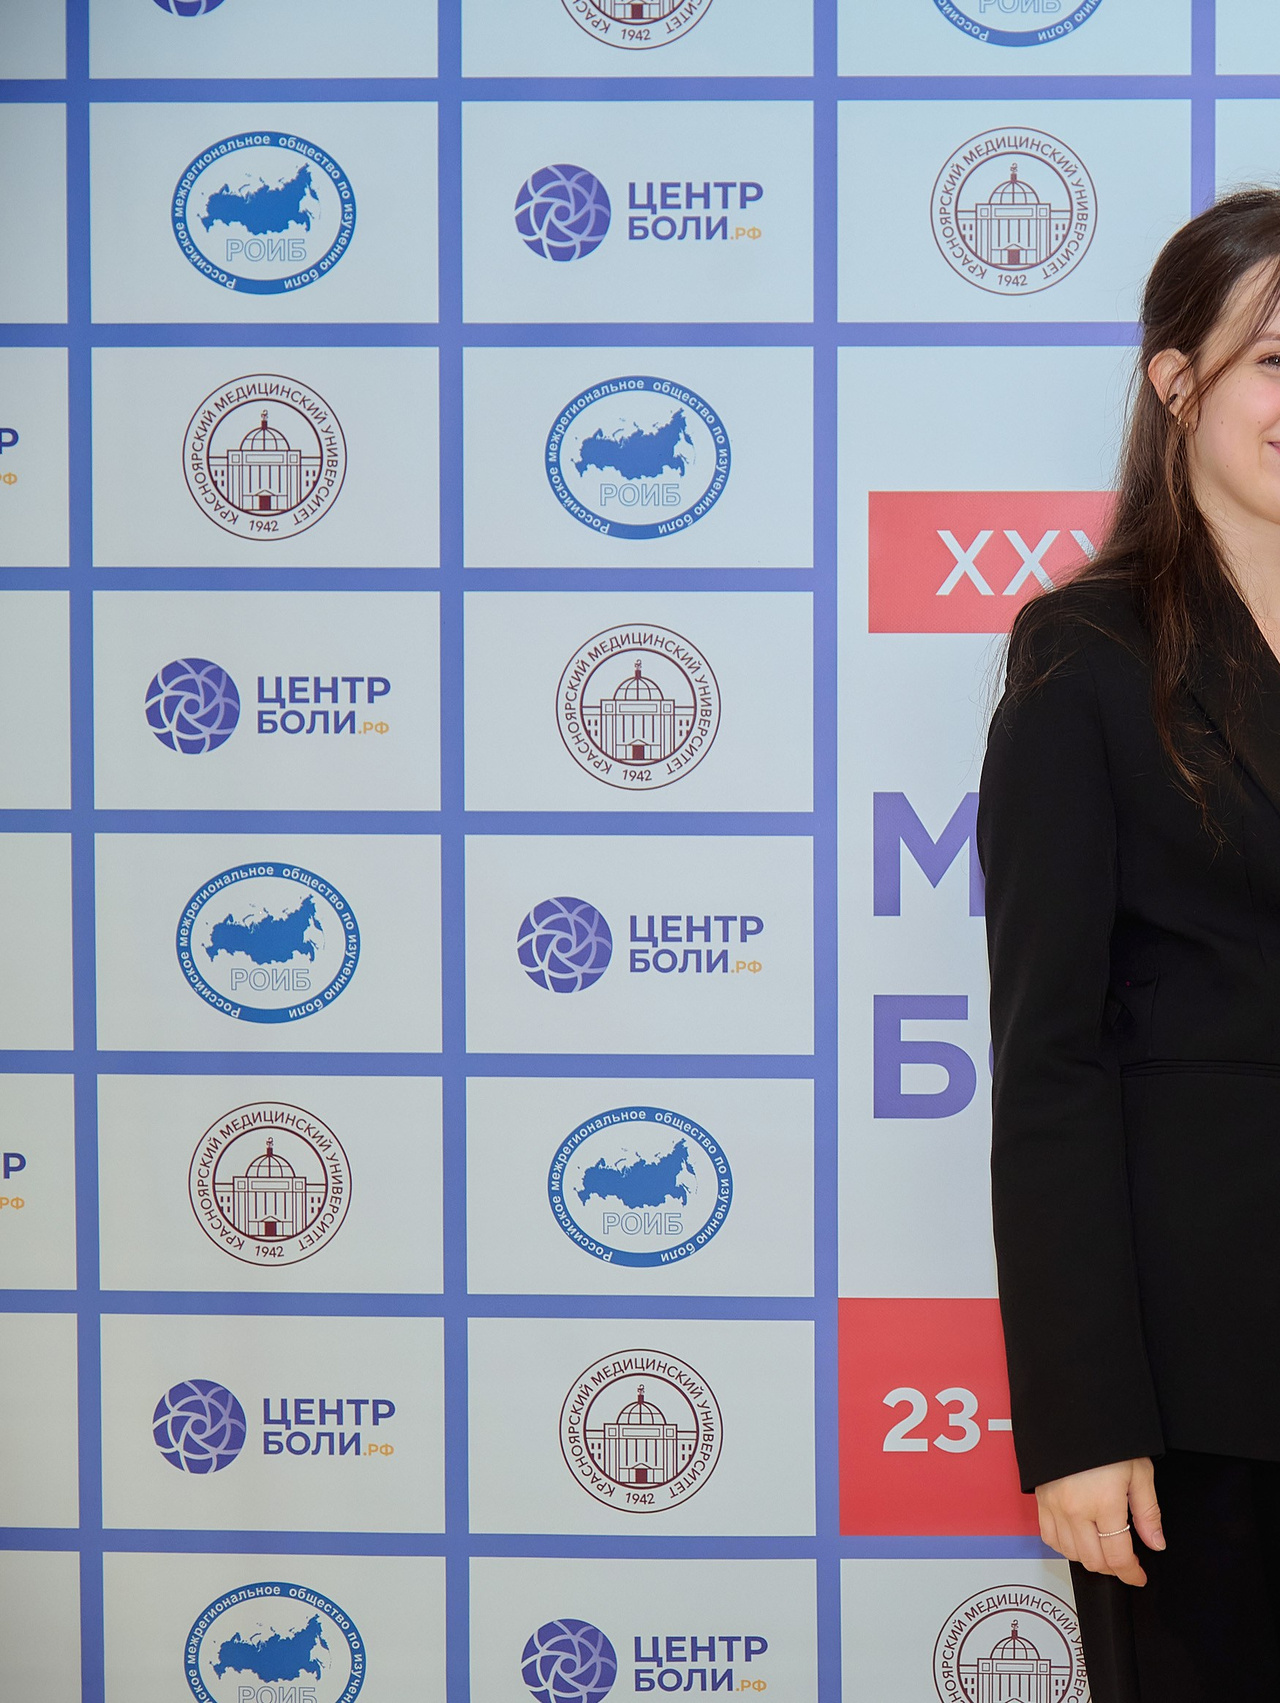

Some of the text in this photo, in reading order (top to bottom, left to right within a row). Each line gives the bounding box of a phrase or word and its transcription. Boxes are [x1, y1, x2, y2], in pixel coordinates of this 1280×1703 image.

[621, 29, 651, 40] 1942
[1038, 20, 1073, 41] боли
[175, 135, 352, 289] Российское межрегиональное общество по изучению боли
[628, 182, 763, 214] ЦЕНТР
[940, 136, 1088, 280] КРАСНОЯРСКИЙ МЕДИЦИНСКИЙ УНИВЕРСИТЕТ
[226, 239, 306, 262] РОИБ
[998, 274, 1028, 286] 1942
[192, 383, 338, 526] КРАСНОЯРСКИЙ МЕДИЦИНСКИЙ УНИВЕРСИТЕТ
[549, 380, 727, 534] Российское межрегиональное общество по изучению боли
[600, 484, 681, 507] РОИБ
[249, 520, 279, 532] 1942
[257, 676, 391, 709] ЦЕНТР
[565, 632, 712, 775] КРАСНОЯРСКИЙ МЕДИЦИНСКИЙ УНИВЕРСИТЕТ
[623, 769, 652, 781] 1942
[179, 866, 357, 1018] Российское межрегиональное общество по изучению боли
[630, 915, 764, 947] ЦЕНТР
[231, 969, 311, 991] РОИБ
[198, 1110, 343, 1251] КРАСНОЯРСКИЙ МЕДИЦИНСКИЙ УНИВЕРСИТЕТ
[551, 1110, 729, 1262] Российское межрегиональное общество по изучению боли
[602, 1213, 683, 1235] РОИБ
[255, 1246, 284, 1257] 1942
[263, 1398, 395, 1430] ЦЕНТР
[568, 1358, 714, 1499] КРАСНОЯРСКИЙ МЕДИЦИНСКИЙ УНИВЕРСИТЕТ
[882, 1386, 1012, 1454] 23-
[626, 1493, 655, 1504] 1942
[187, 1585, 281, 1665] межрегиональное
[289, 1588, 350, 1629] общество
[347, 1632, 360, 1649] по
[634, 1636, 768, 1667] ЦЕНТР
[941, 1619, 967, 1703] НОЯРСКИЙ
[965, 1593, 1078, 1634] МЕДИЦИНСКИЙ
